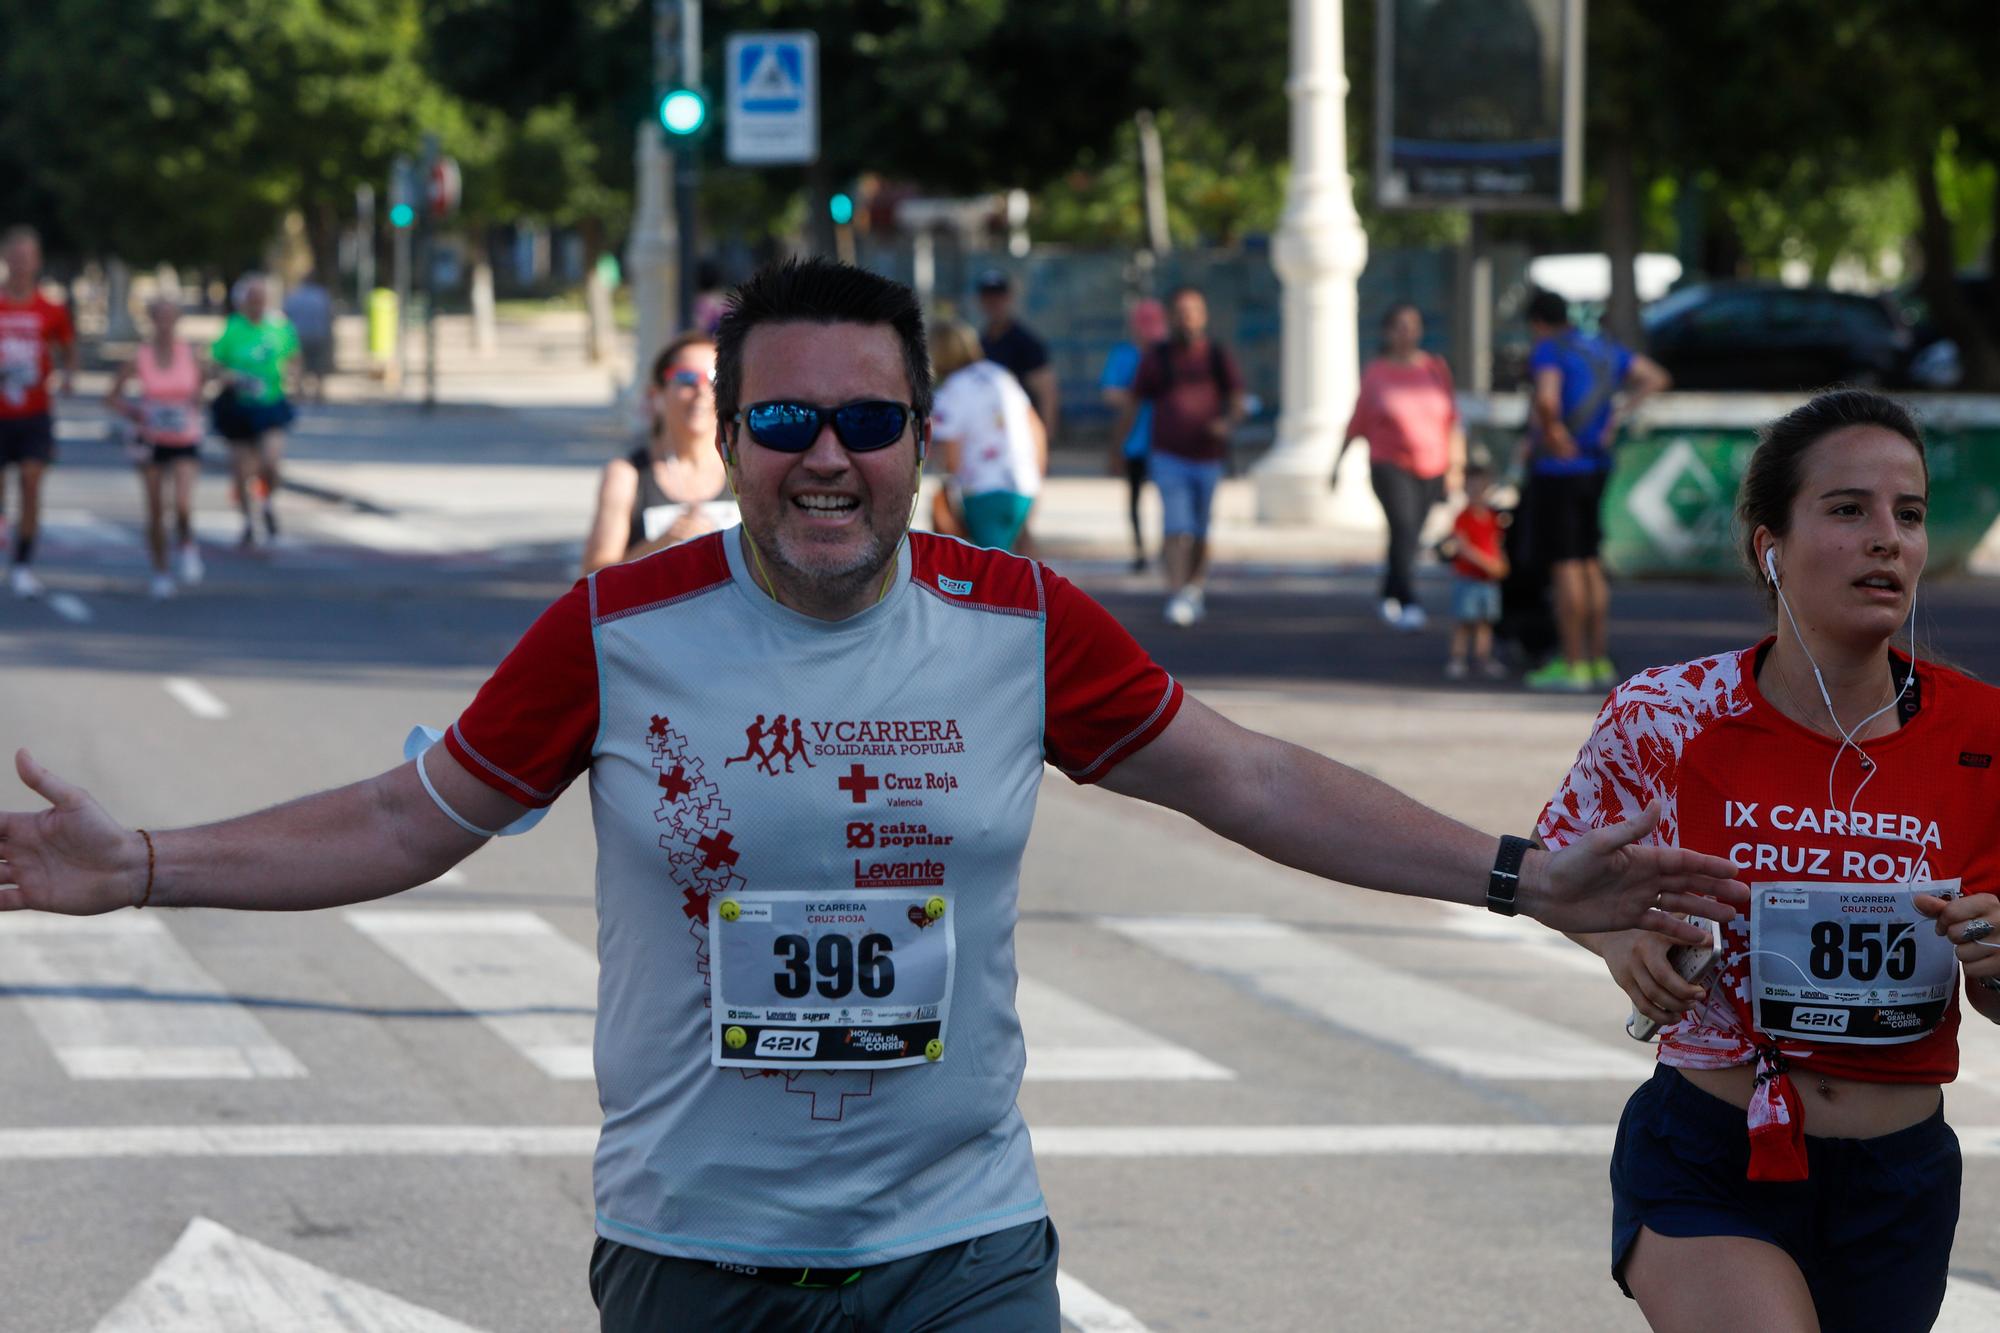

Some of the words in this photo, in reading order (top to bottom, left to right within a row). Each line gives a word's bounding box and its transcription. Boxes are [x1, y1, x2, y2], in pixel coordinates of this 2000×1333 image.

[835, 719, 963, 742] CARRERA
[814, 744, 897, 756] SOLIDARIA
[900, 742, 966, 755] POPULAR
[884, 773, 922, 789] Cruz
[925, 772, 958, 793] Roja
[887, 797, 923, 807] Valencia
[879, 823, 927, 834] caixa
[1725, 801, 1758, 827] IX
[1770, 807, 1942, 850] CARRERA
[879, 833, 954, 848] popular
[855, 859, 945, 879] Levante
[1729, 842, 1830, 875] CRUZ
[1842, 850, 1934, 883] ROJA
[806, 904, 815, 912] IX
[818, 903, 867, 912] CARRERA
[1852, 896, 1896, 904] CARRERA
[808, 915, 836, 923] CRUZ
[838, 914, 865, 923] ROJA
[1809, 921, 1916, 981] 855
[774, 933, 895, 999] 396
[803, 1012, 830, 1022] SUPER
[1796, 1013, 1845, 1027] 42K
[761, 1036, 813, 1051] 42K
